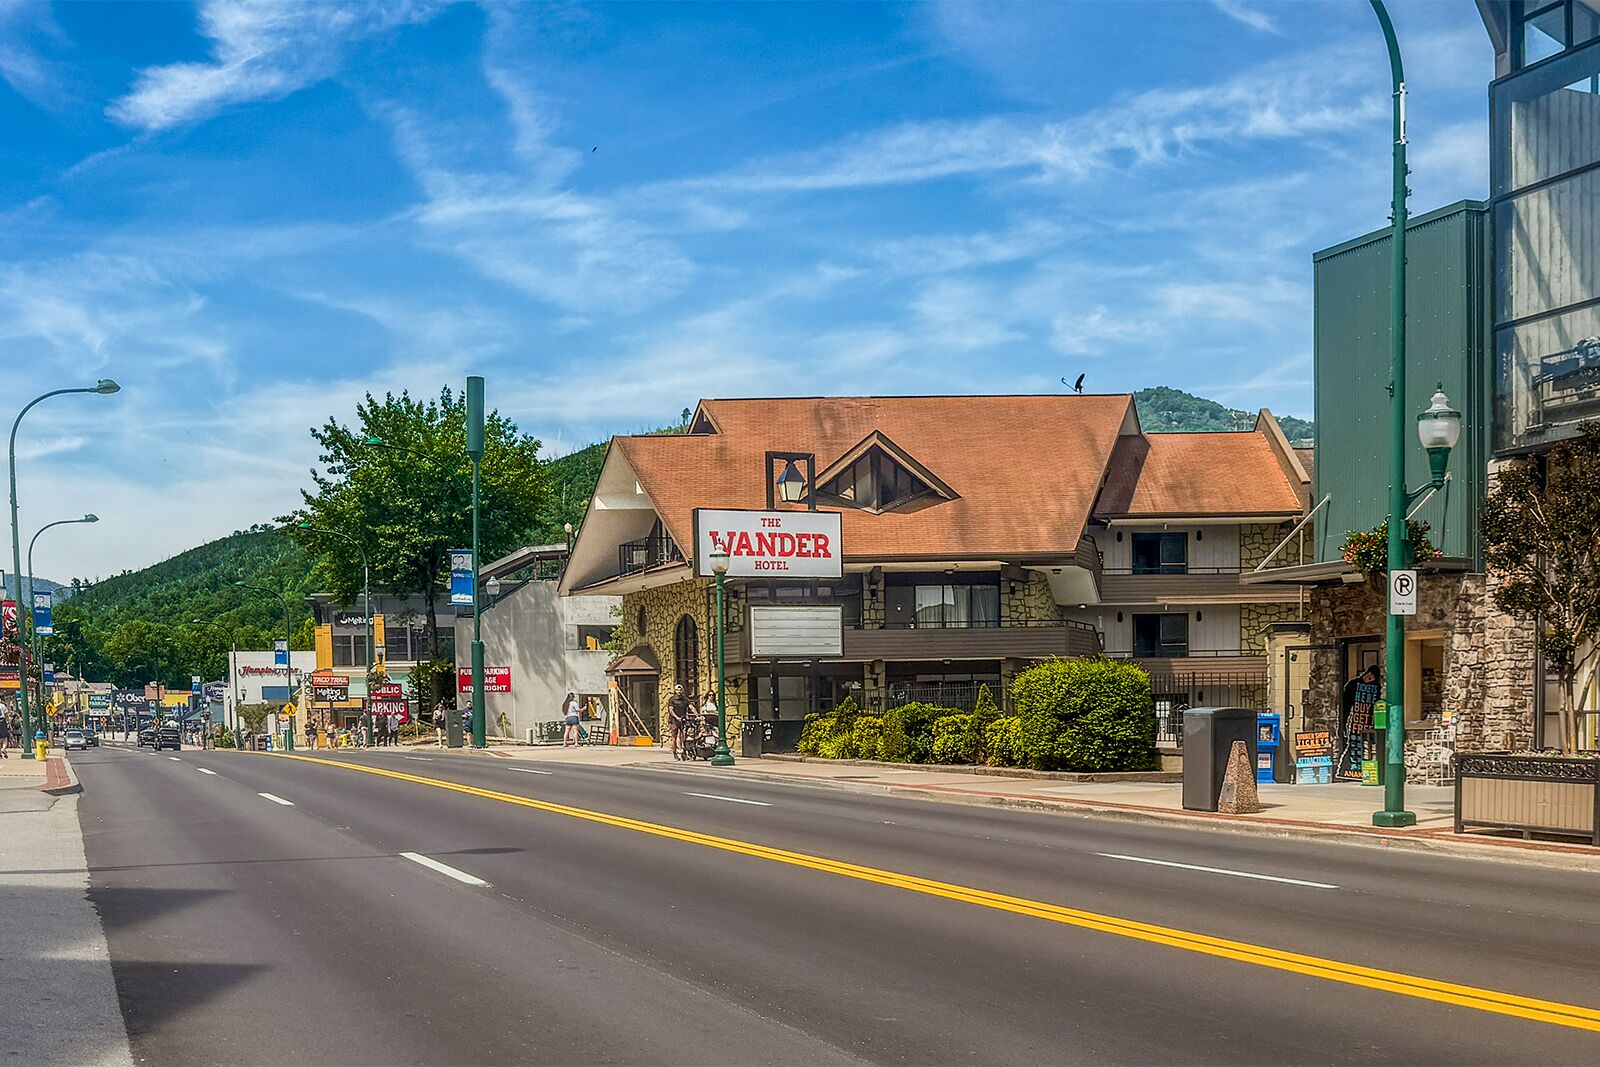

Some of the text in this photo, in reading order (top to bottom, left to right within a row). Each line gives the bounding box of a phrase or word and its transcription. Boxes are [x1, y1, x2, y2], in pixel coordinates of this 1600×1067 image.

[761, 518, 781, 528] THE
[709, 531, 832, 558] WANDER
[755, 561, 789, 570] HOTEL
[331, 675, 349, 683] TRAIL
[317, 688, 341, 696] Melting
[370, 686, 400, 694] UBLIC
[1356, 682, 1378, 694] TICKETS
[1354, 692, 1377, 704] HERE
[369, 702, 405, 713] ARKING
[1354, 702, 1371, 714] BUY
[1353, 713, 1371, 724] GET
[1297, 738, 1329, 746] TICKETS
